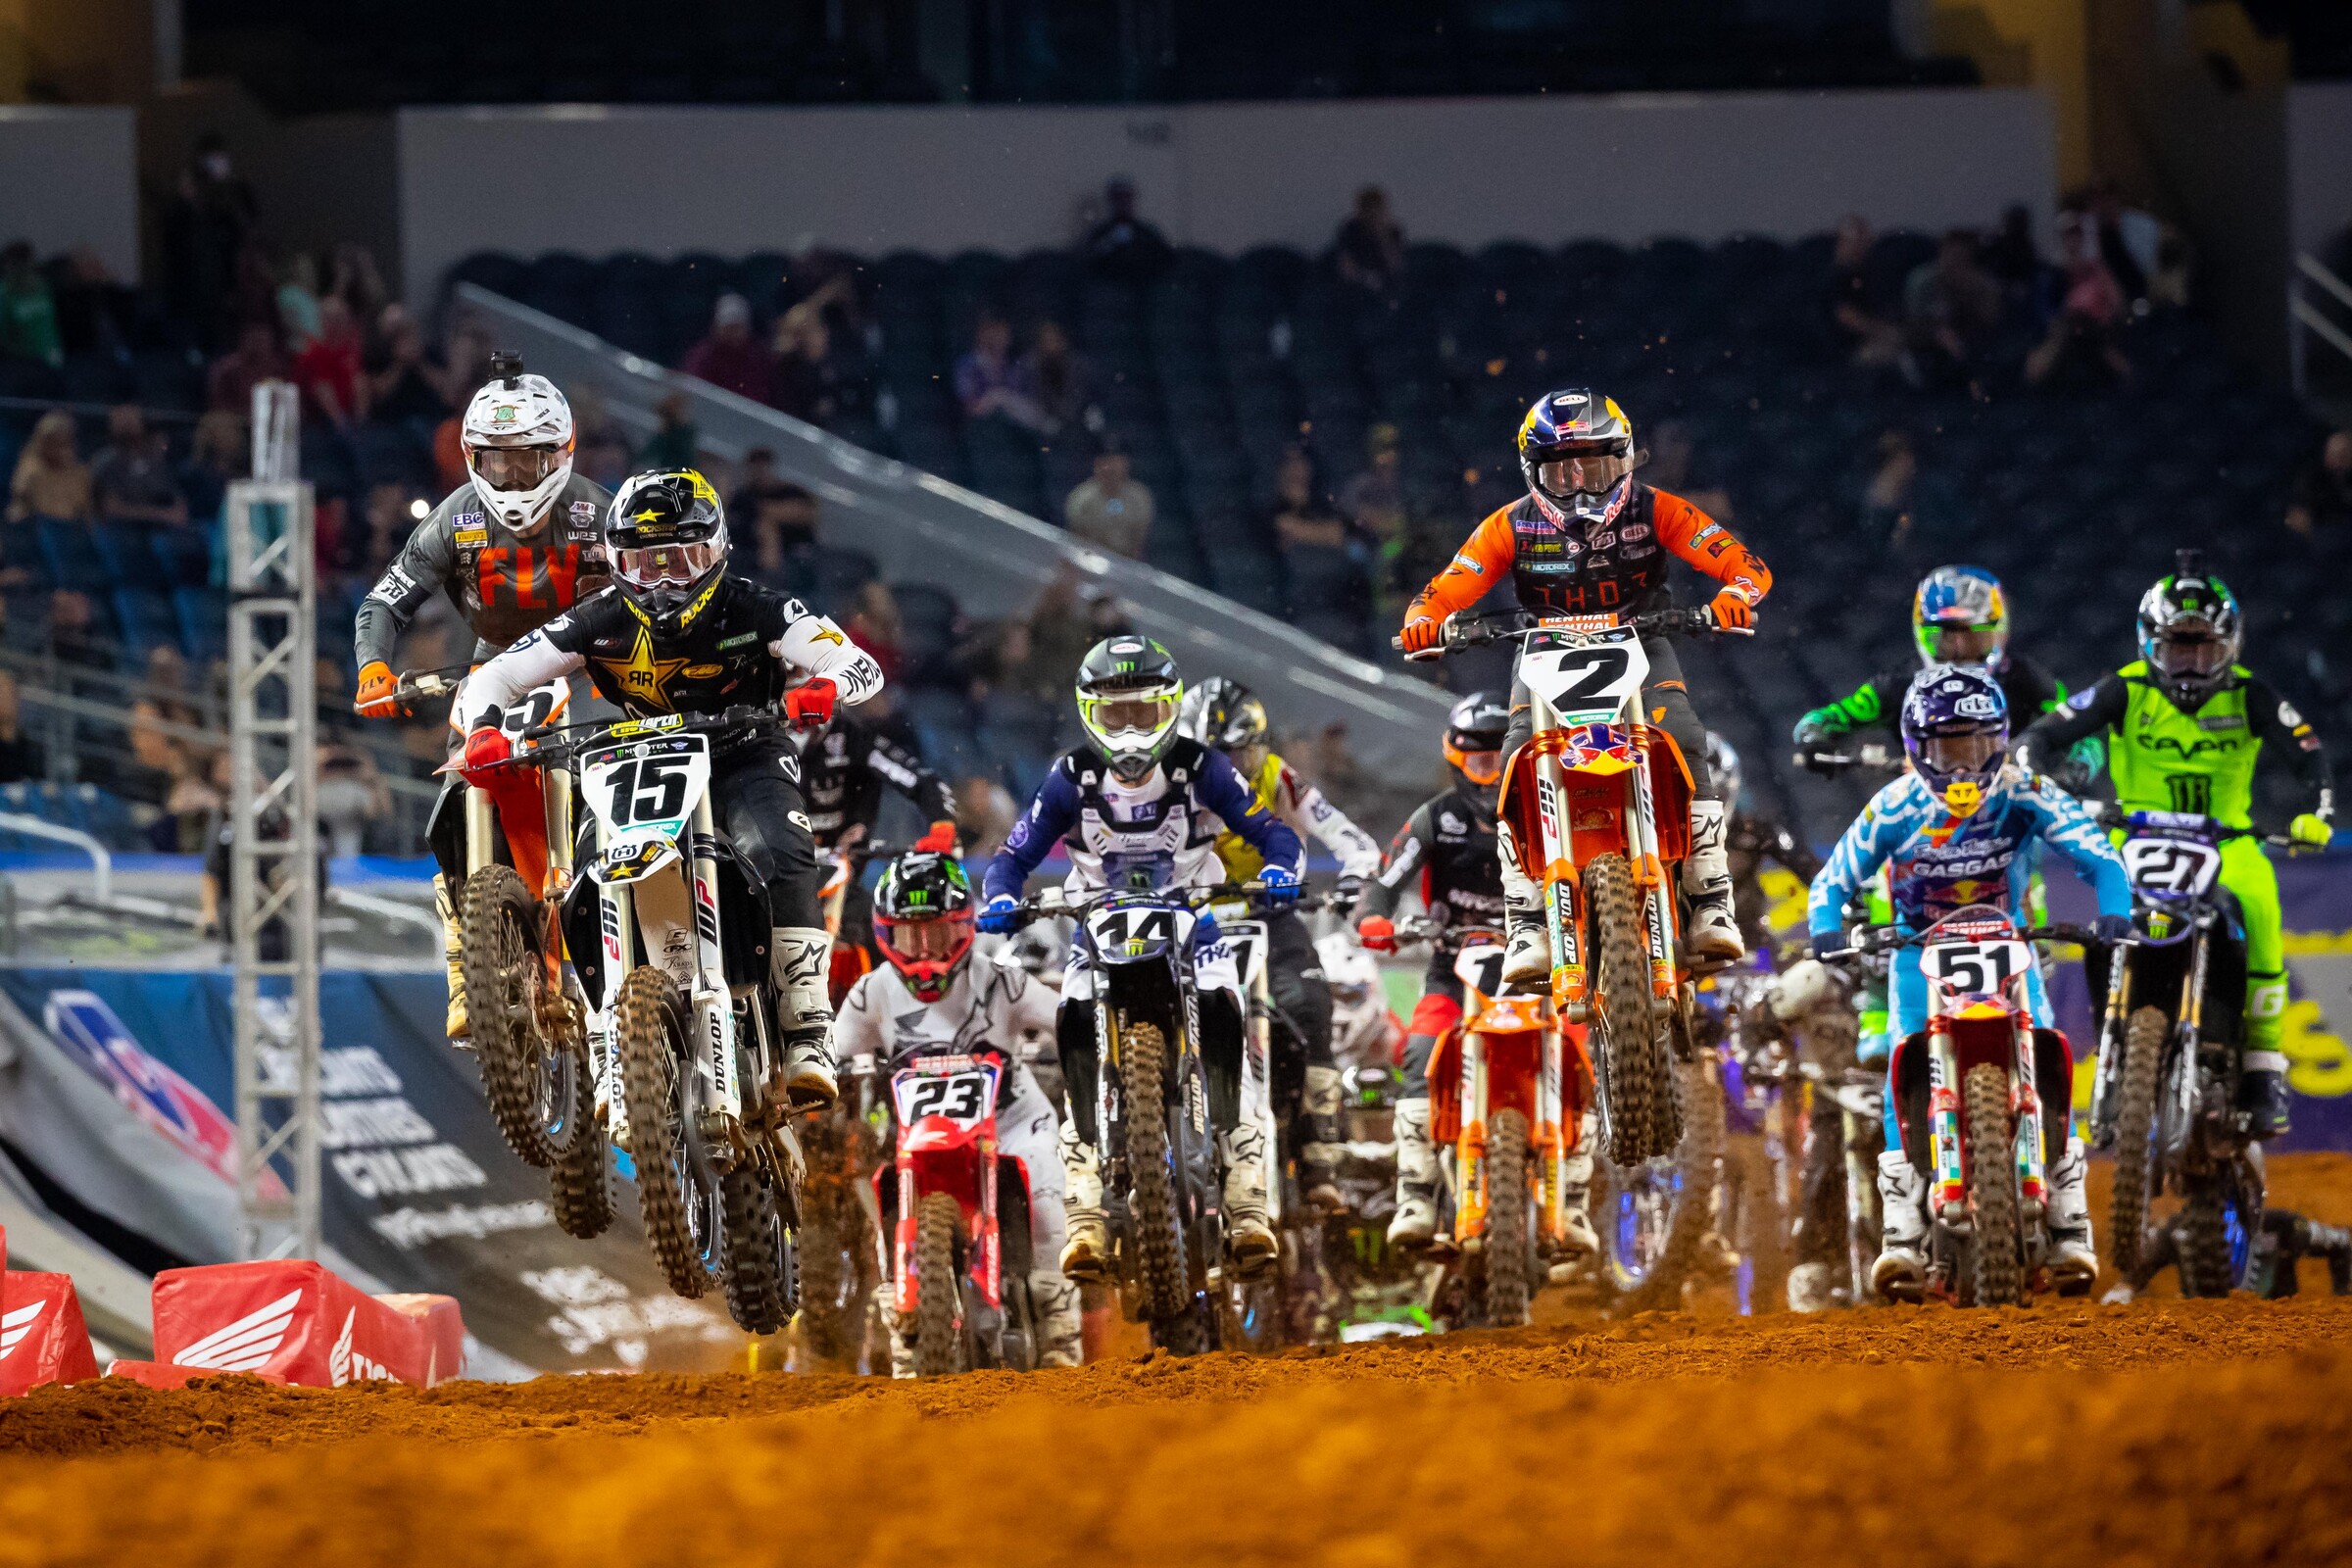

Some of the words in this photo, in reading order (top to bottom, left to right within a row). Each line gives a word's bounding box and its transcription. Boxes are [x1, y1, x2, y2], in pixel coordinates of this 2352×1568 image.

[453, 512, 484, 527] EBC
[567, 530, 598, 542] WPS
[635, 523, 677, 534] ROCKSTAR
[1624, 525, 1647, 538] BELL
[478, 543, 580, 610] FLY
[1532, 563, 1572, 571] MOTOREX
[723, 632, 758, 647] MOTOREX
[1545, 614, 1612, 624] RENTHAL
[361, 675, 386, 696] FLY
[1551, 648, 1630, 712] 2
[605, 756, 692, 827] 15
[1912, 850, 2014, 878] GASGAS
[1097, 910, 1174, 952] 14
[1546, 909, 1561, 967] MOTOREX
[1646, 890, 1663, 960] DUNLOP
[1937, 945, 2011, 999] 51
[709, 1011, 726, 1095] DUNLOP
[910, 1079, 981, 1125] 23
[1191, 1073, 1205, 1135] DUNLOP
